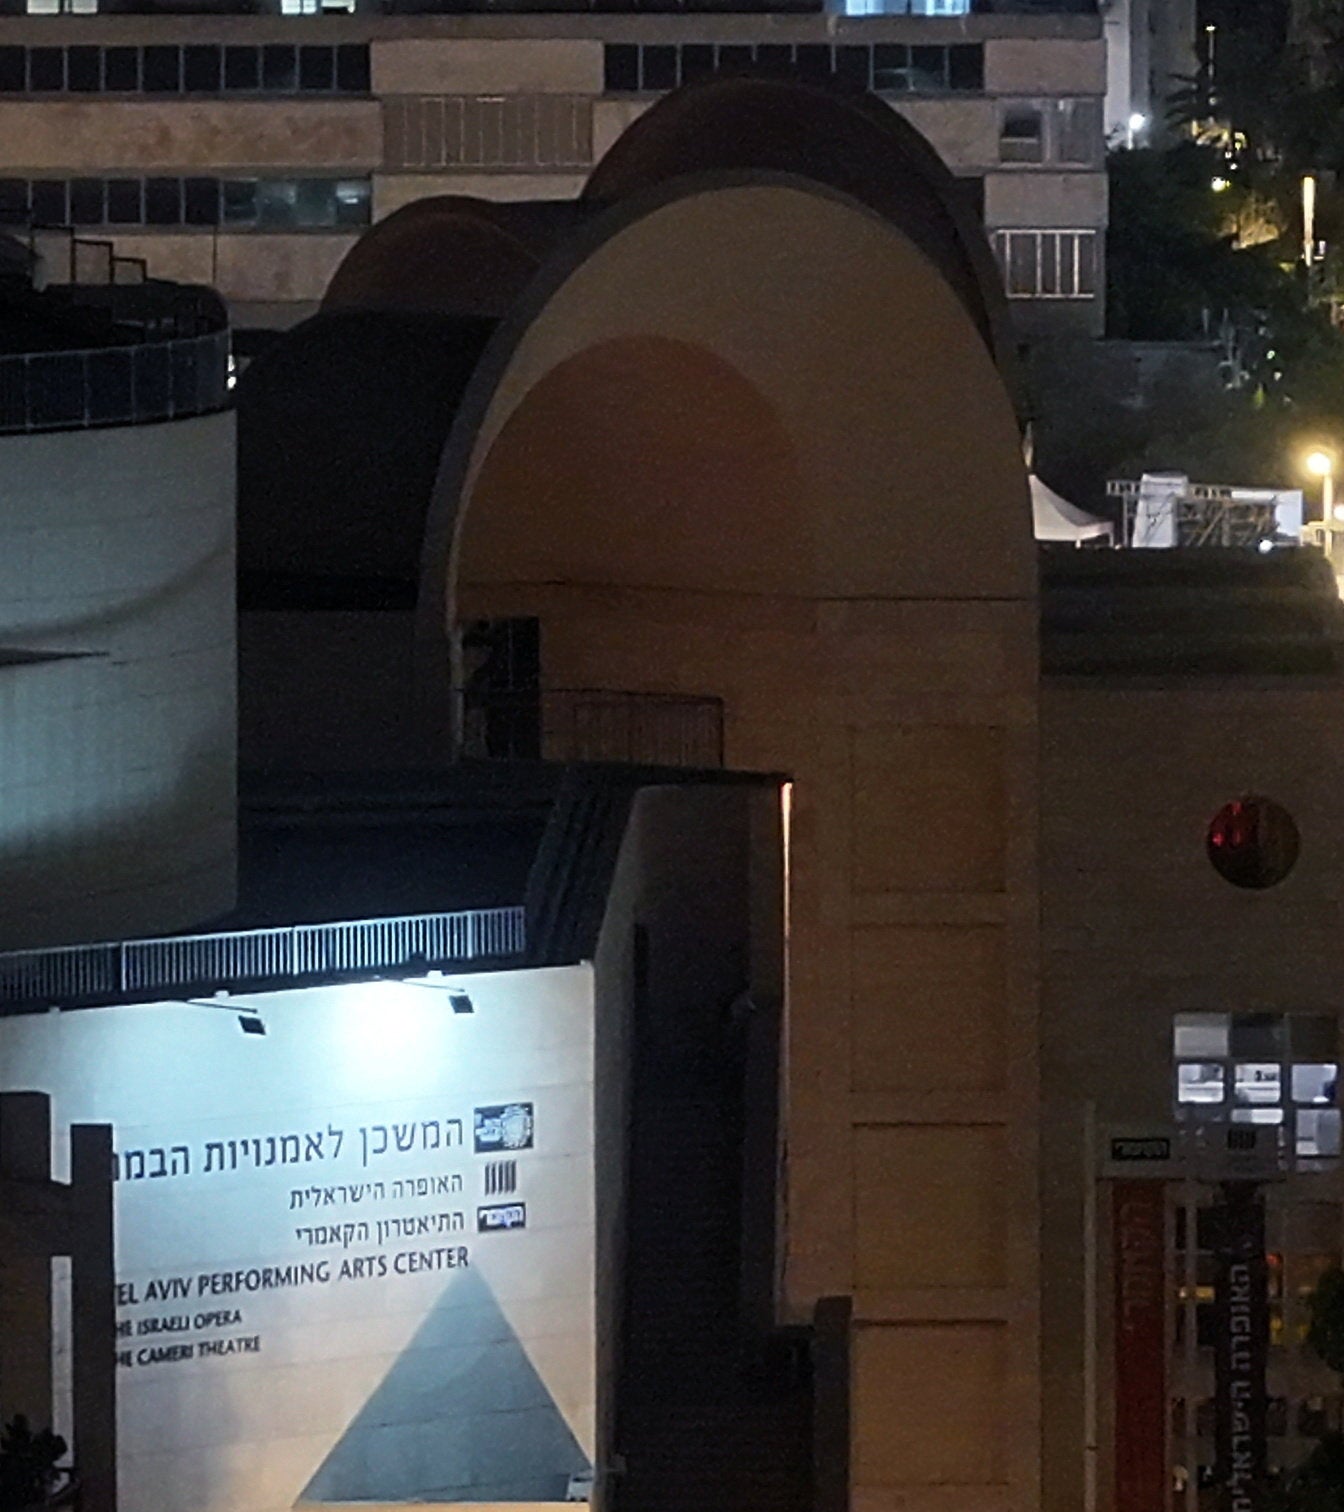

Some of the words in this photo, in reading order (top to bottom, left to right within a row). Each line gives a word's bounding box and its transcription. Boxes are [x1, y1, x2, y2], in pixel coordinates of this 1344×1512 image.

[203, 1124, 343, 1173] לאמנויות
[360, 1118, 463, 1167] המשכן
[289, 1182, 385, 1209] הישראלית
[392, 1174, 463, 1199] האופרה
[296, 1222, 368, 1248] הקאמרי
[376, 1212, 464, 1245] התיאטרון
[115, 1283, 138, 1306] EL
[144, 1277, 193, 1301] AVIV
[198, 1261, 330, 1297] PERFORMING
[338, 1255, 387, 1279] ARTS
[394, 1246, 469, 1274] CENTER
[116, 1320, 132, 1338] HE
[137, 1314, 190, 1335] ISRAELI
[194, 1309, 242, 1330] OPERA
[116, 1349, 132, 1368] HE
[137, 1343, 194, 1366] CAMERI
[198, 1335, 260, 1358] THEATRE
